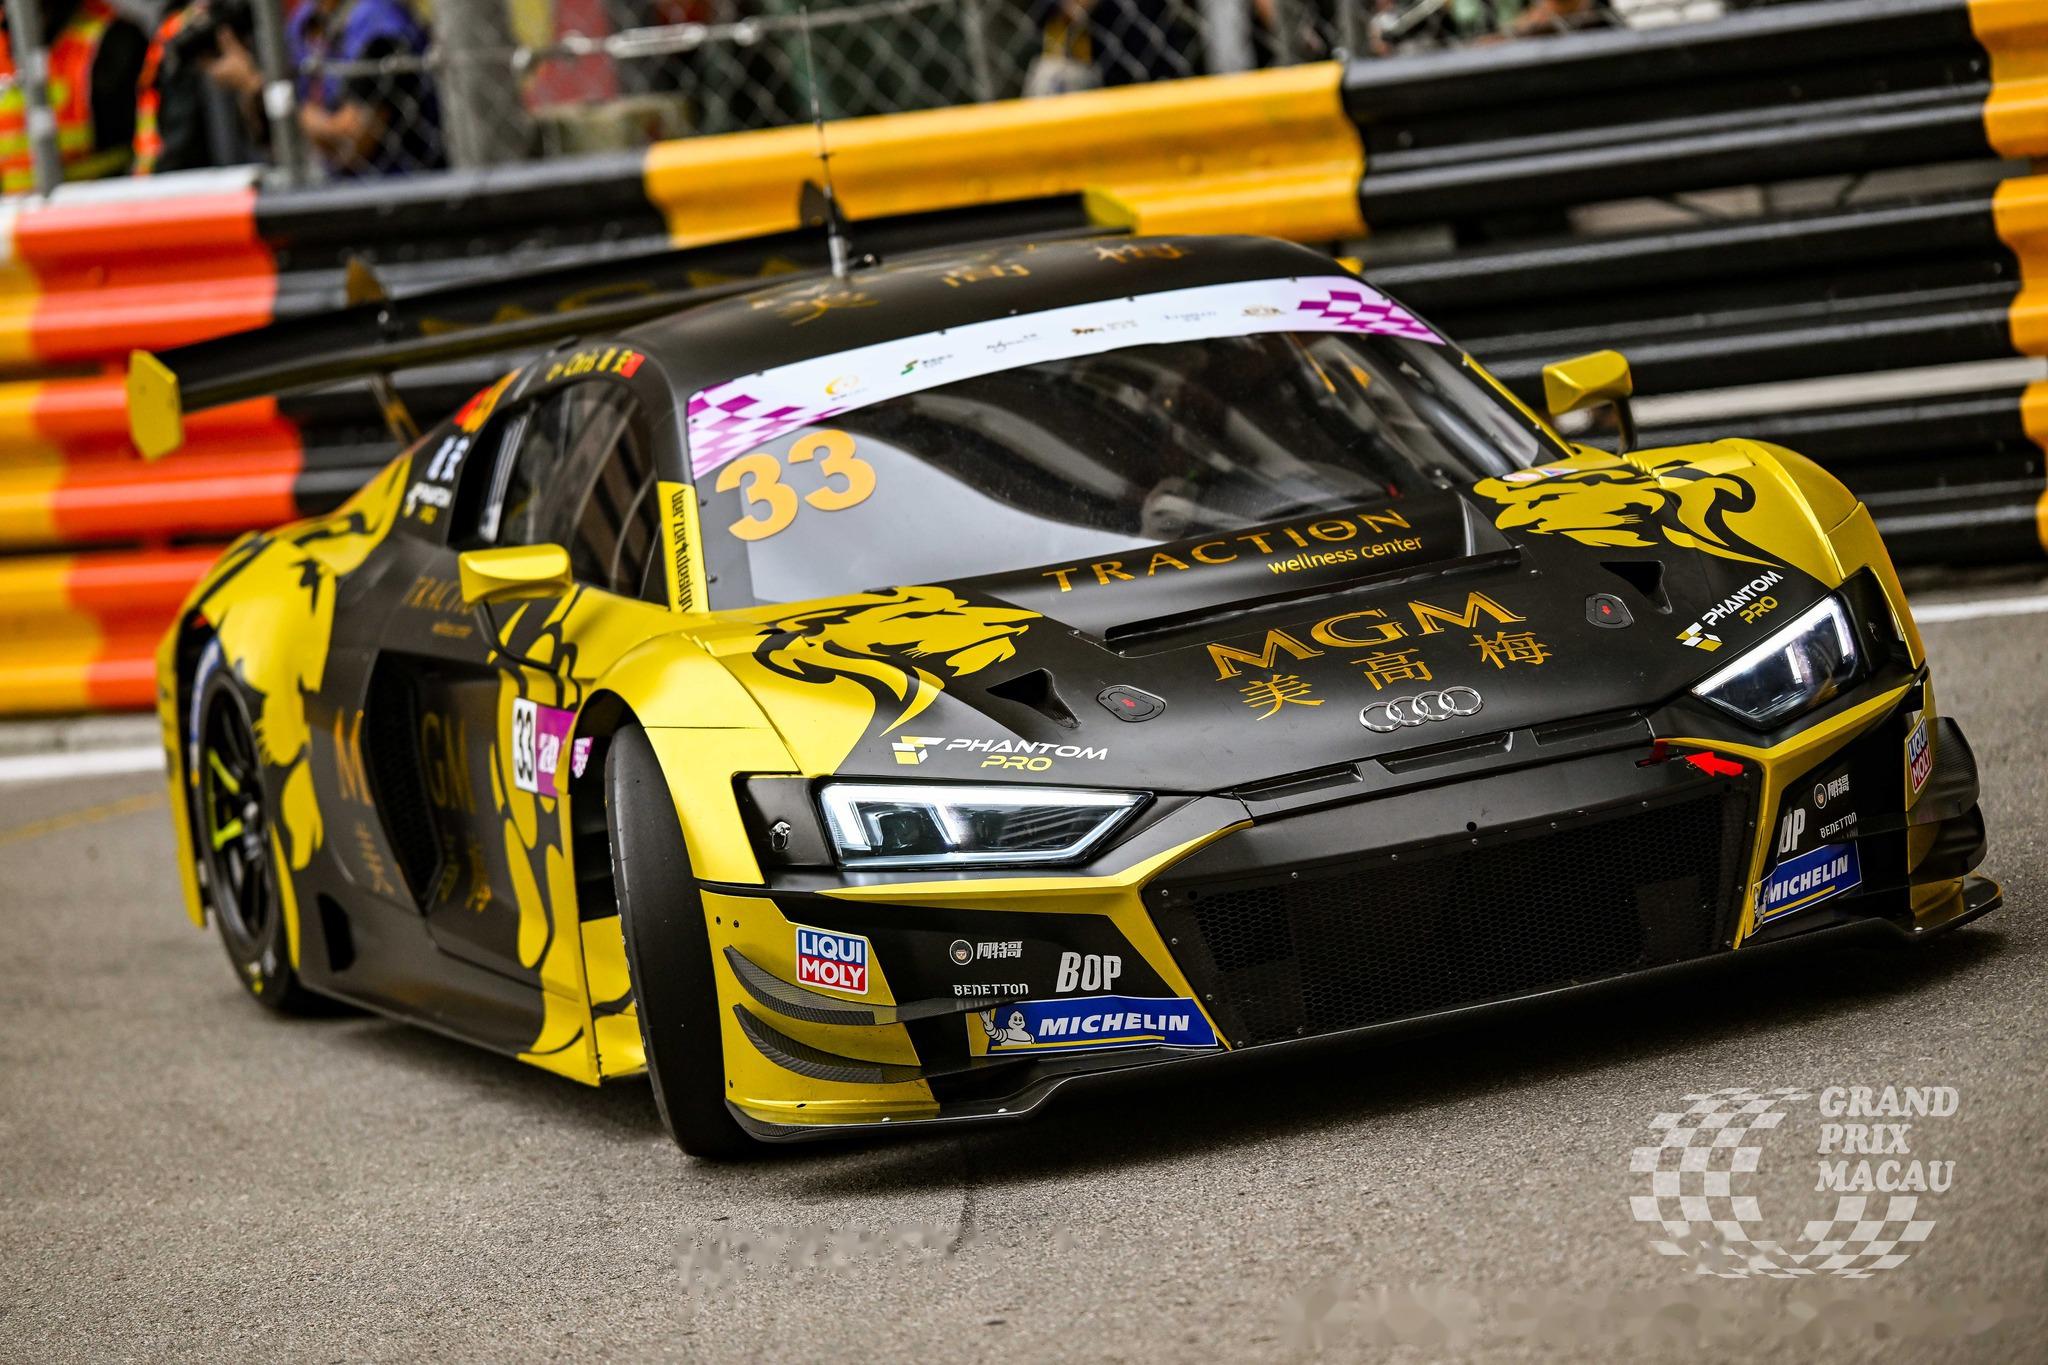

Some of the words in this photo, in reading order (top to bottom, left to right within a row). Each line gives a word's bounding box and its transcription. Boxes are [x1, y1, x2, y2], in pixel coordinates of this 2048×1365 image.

[715, 429, 877, 541] 33
[1042, 508, 1412, 593] TRACTION
[1267, 549, 1357, 575] wellness
[1361, 536, 1423, 558] center
[1701, 570, 1784, 627] PHANTOM
[1739, 595, 1778, 625] PRO
[1206, 591, 1527, 681] MGM
[1239, 631, 1552, 721] 美高梅
[517, 708, 533, 783] 33
[945, 738, 1108, 761] PHANTOM
[980, 755, 1053, 772] PRO
[1767, 854, 1849, 905] MICHELIN
[801, 932, 862, 963] LIQUI
[976, 941, 1023, 960] 阿特哥
[801, 957, 864, 988] MOLY
[952, 983, 1029, 996] BENETTON
[1055, 951, 1121, 993] BOP
[1038, 1012, 1190, 1037] MICHELIN
